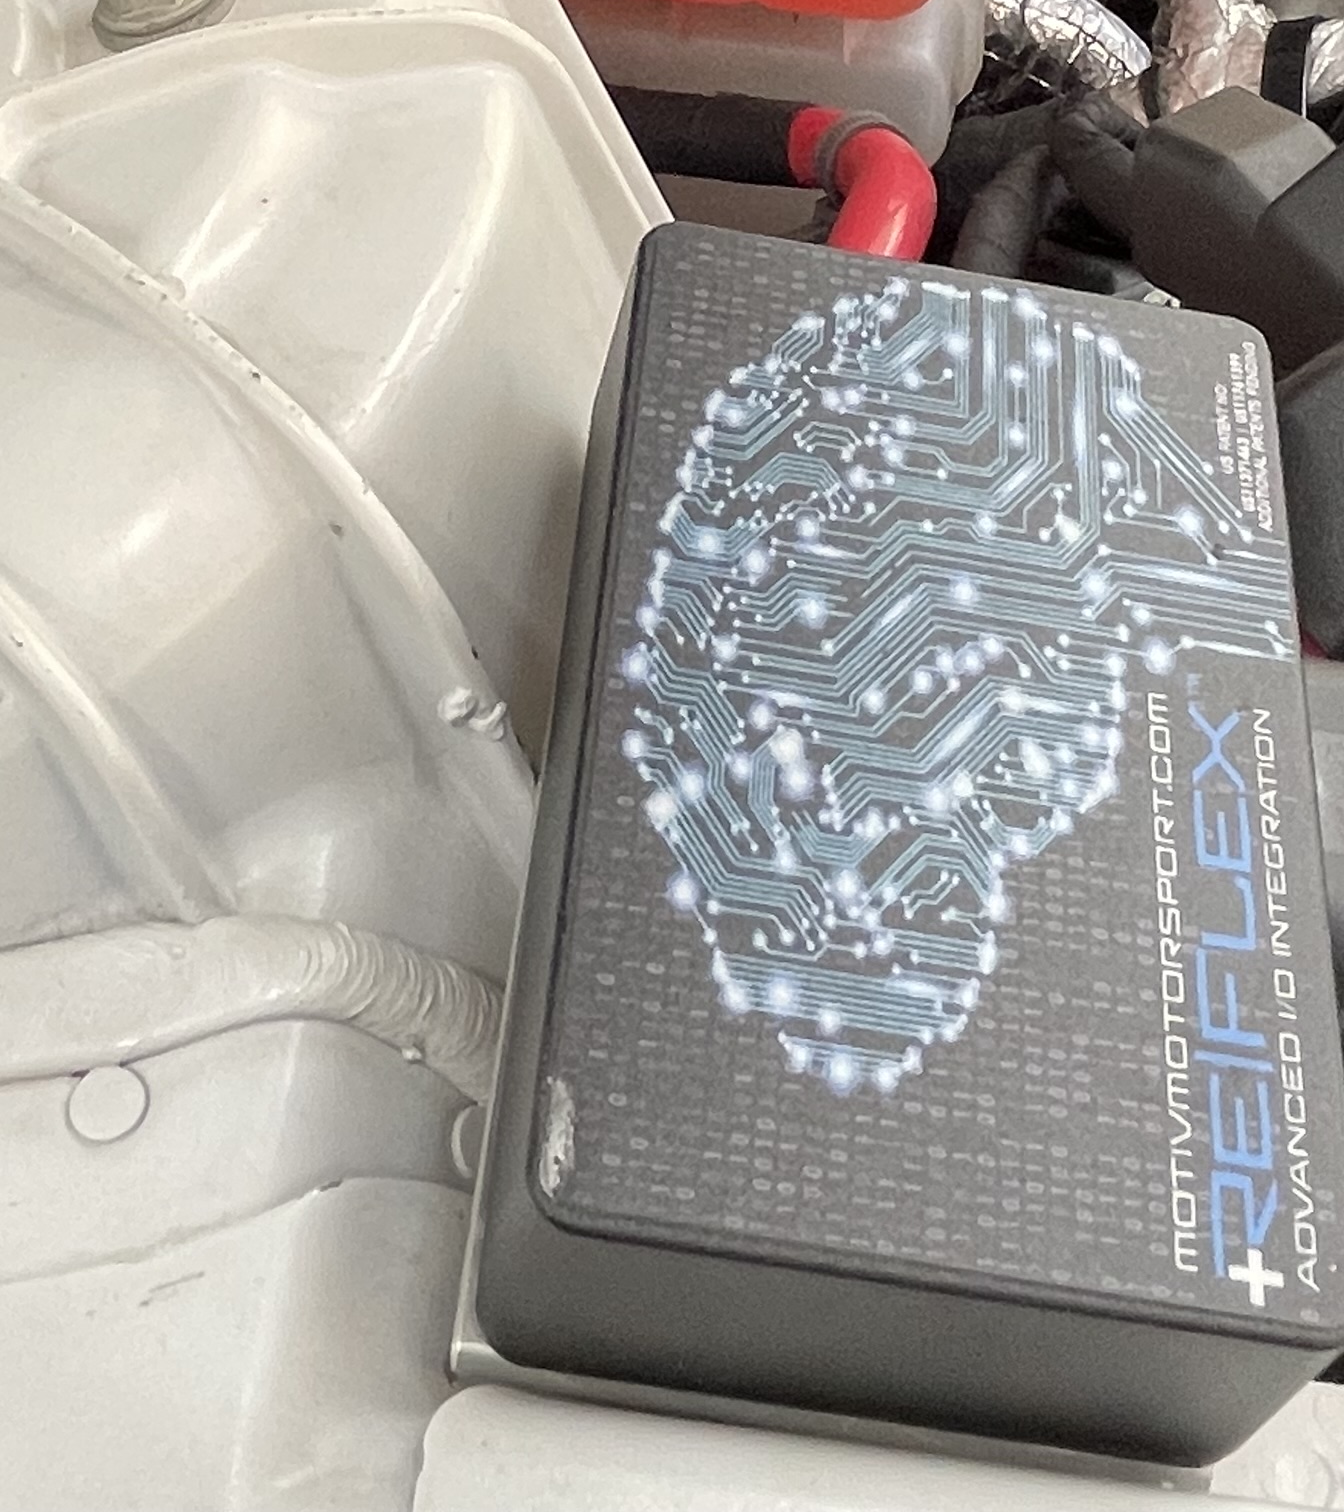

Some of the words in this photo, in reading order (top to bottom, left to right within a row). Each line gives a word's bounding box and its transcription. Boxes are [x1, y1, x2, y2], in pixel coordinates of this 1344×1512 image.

[1242, 341, 1259, 396] PENDING
[1216, 406, 1232, 451] PATENT
[1248, 399, 1265, 452] PATENTS
[1254, 455, 1273, 532] ADDITIONAL
[1252, 707, 1293, 958] INTEGRATION
[1147, 691, 1199, 1274] MOTIVMOTORSPORT.COM
[1273, 968, 1298, 1021] I/O
[1278, 1031, 1322, 1294] ADVANCED
